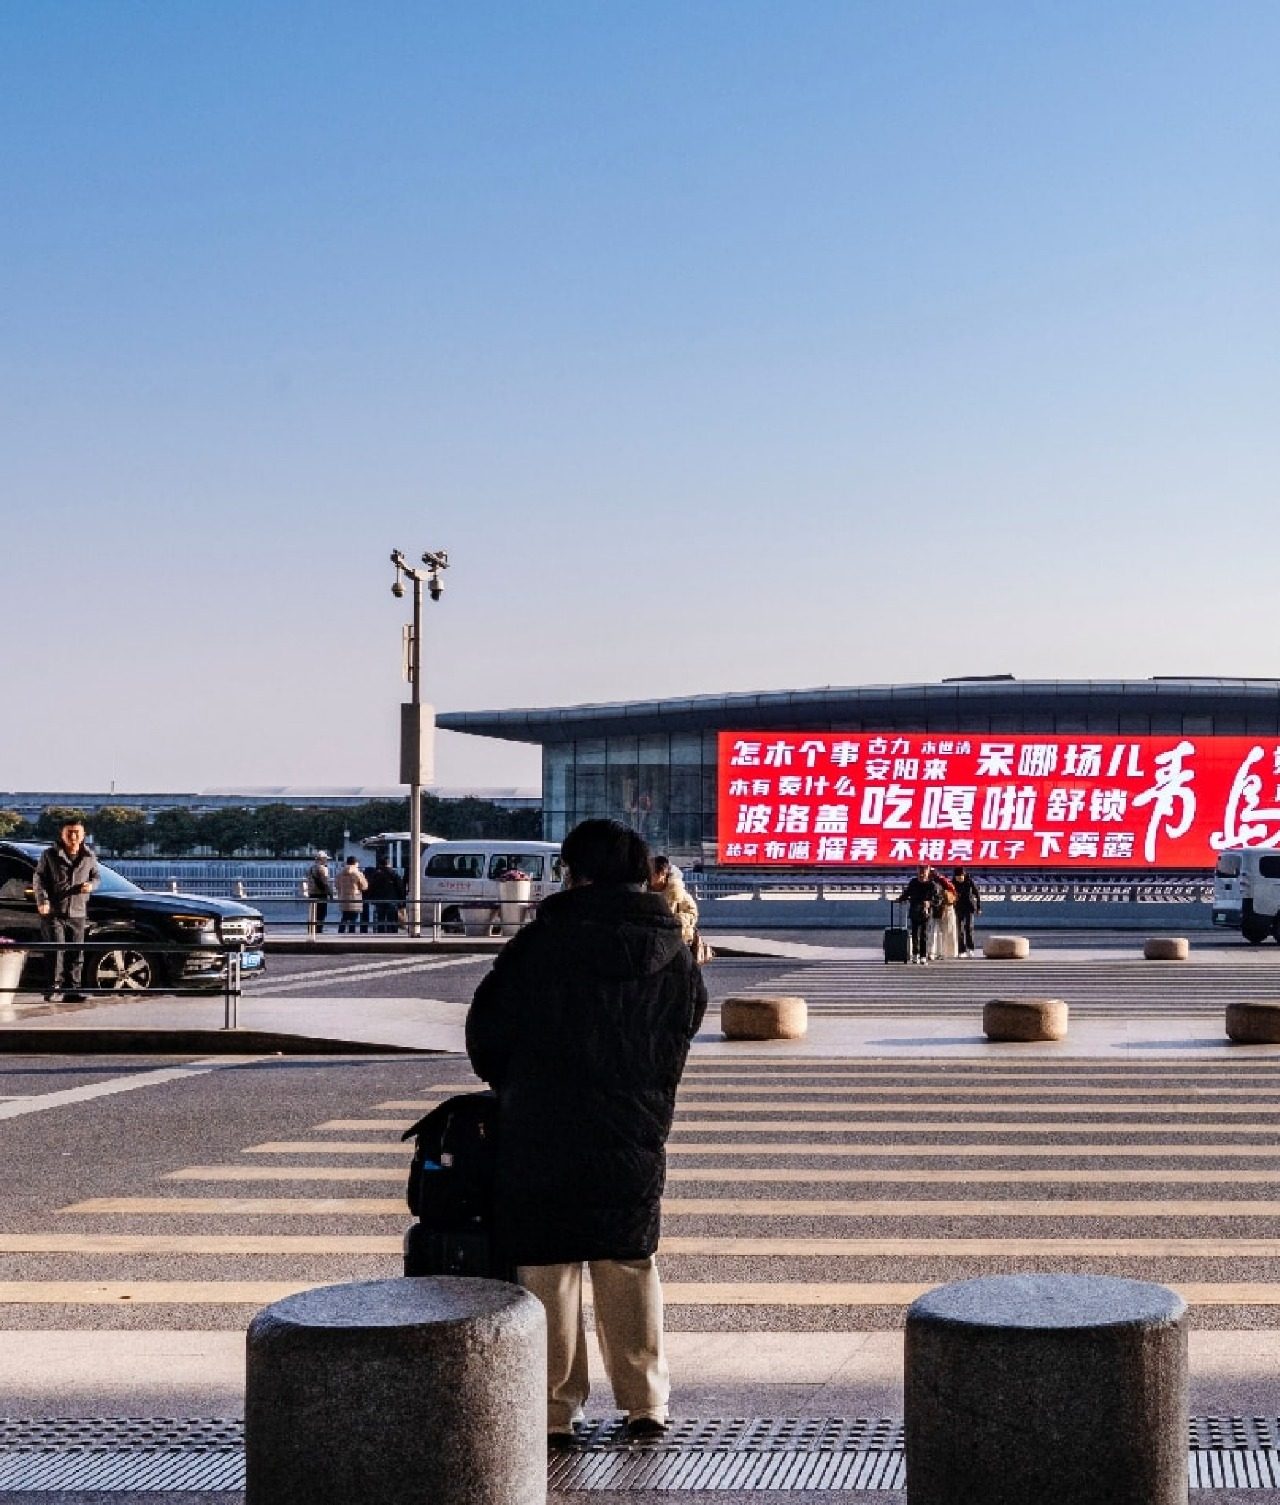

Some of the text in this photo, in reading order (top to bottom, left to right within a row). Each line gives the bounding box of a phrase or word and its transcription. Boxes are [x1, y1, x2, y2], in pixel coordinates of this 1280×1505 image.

[731, 741, 860, 767] 怎木个事
[868, 737, 910, 754] 古力
[864, 758, 948, 780] 安阳来
[976, 743, 1144, 777] 呆哪场儿
[729, 779, 771, 796] 木有
[860, 784, 1037, 831] 吃嘎啦
[1046, 788, 1127, 821] 舒锁
[736, 804, 848, 833] 波洛盖
[1033, 832, 1134, 858] 下雾露
